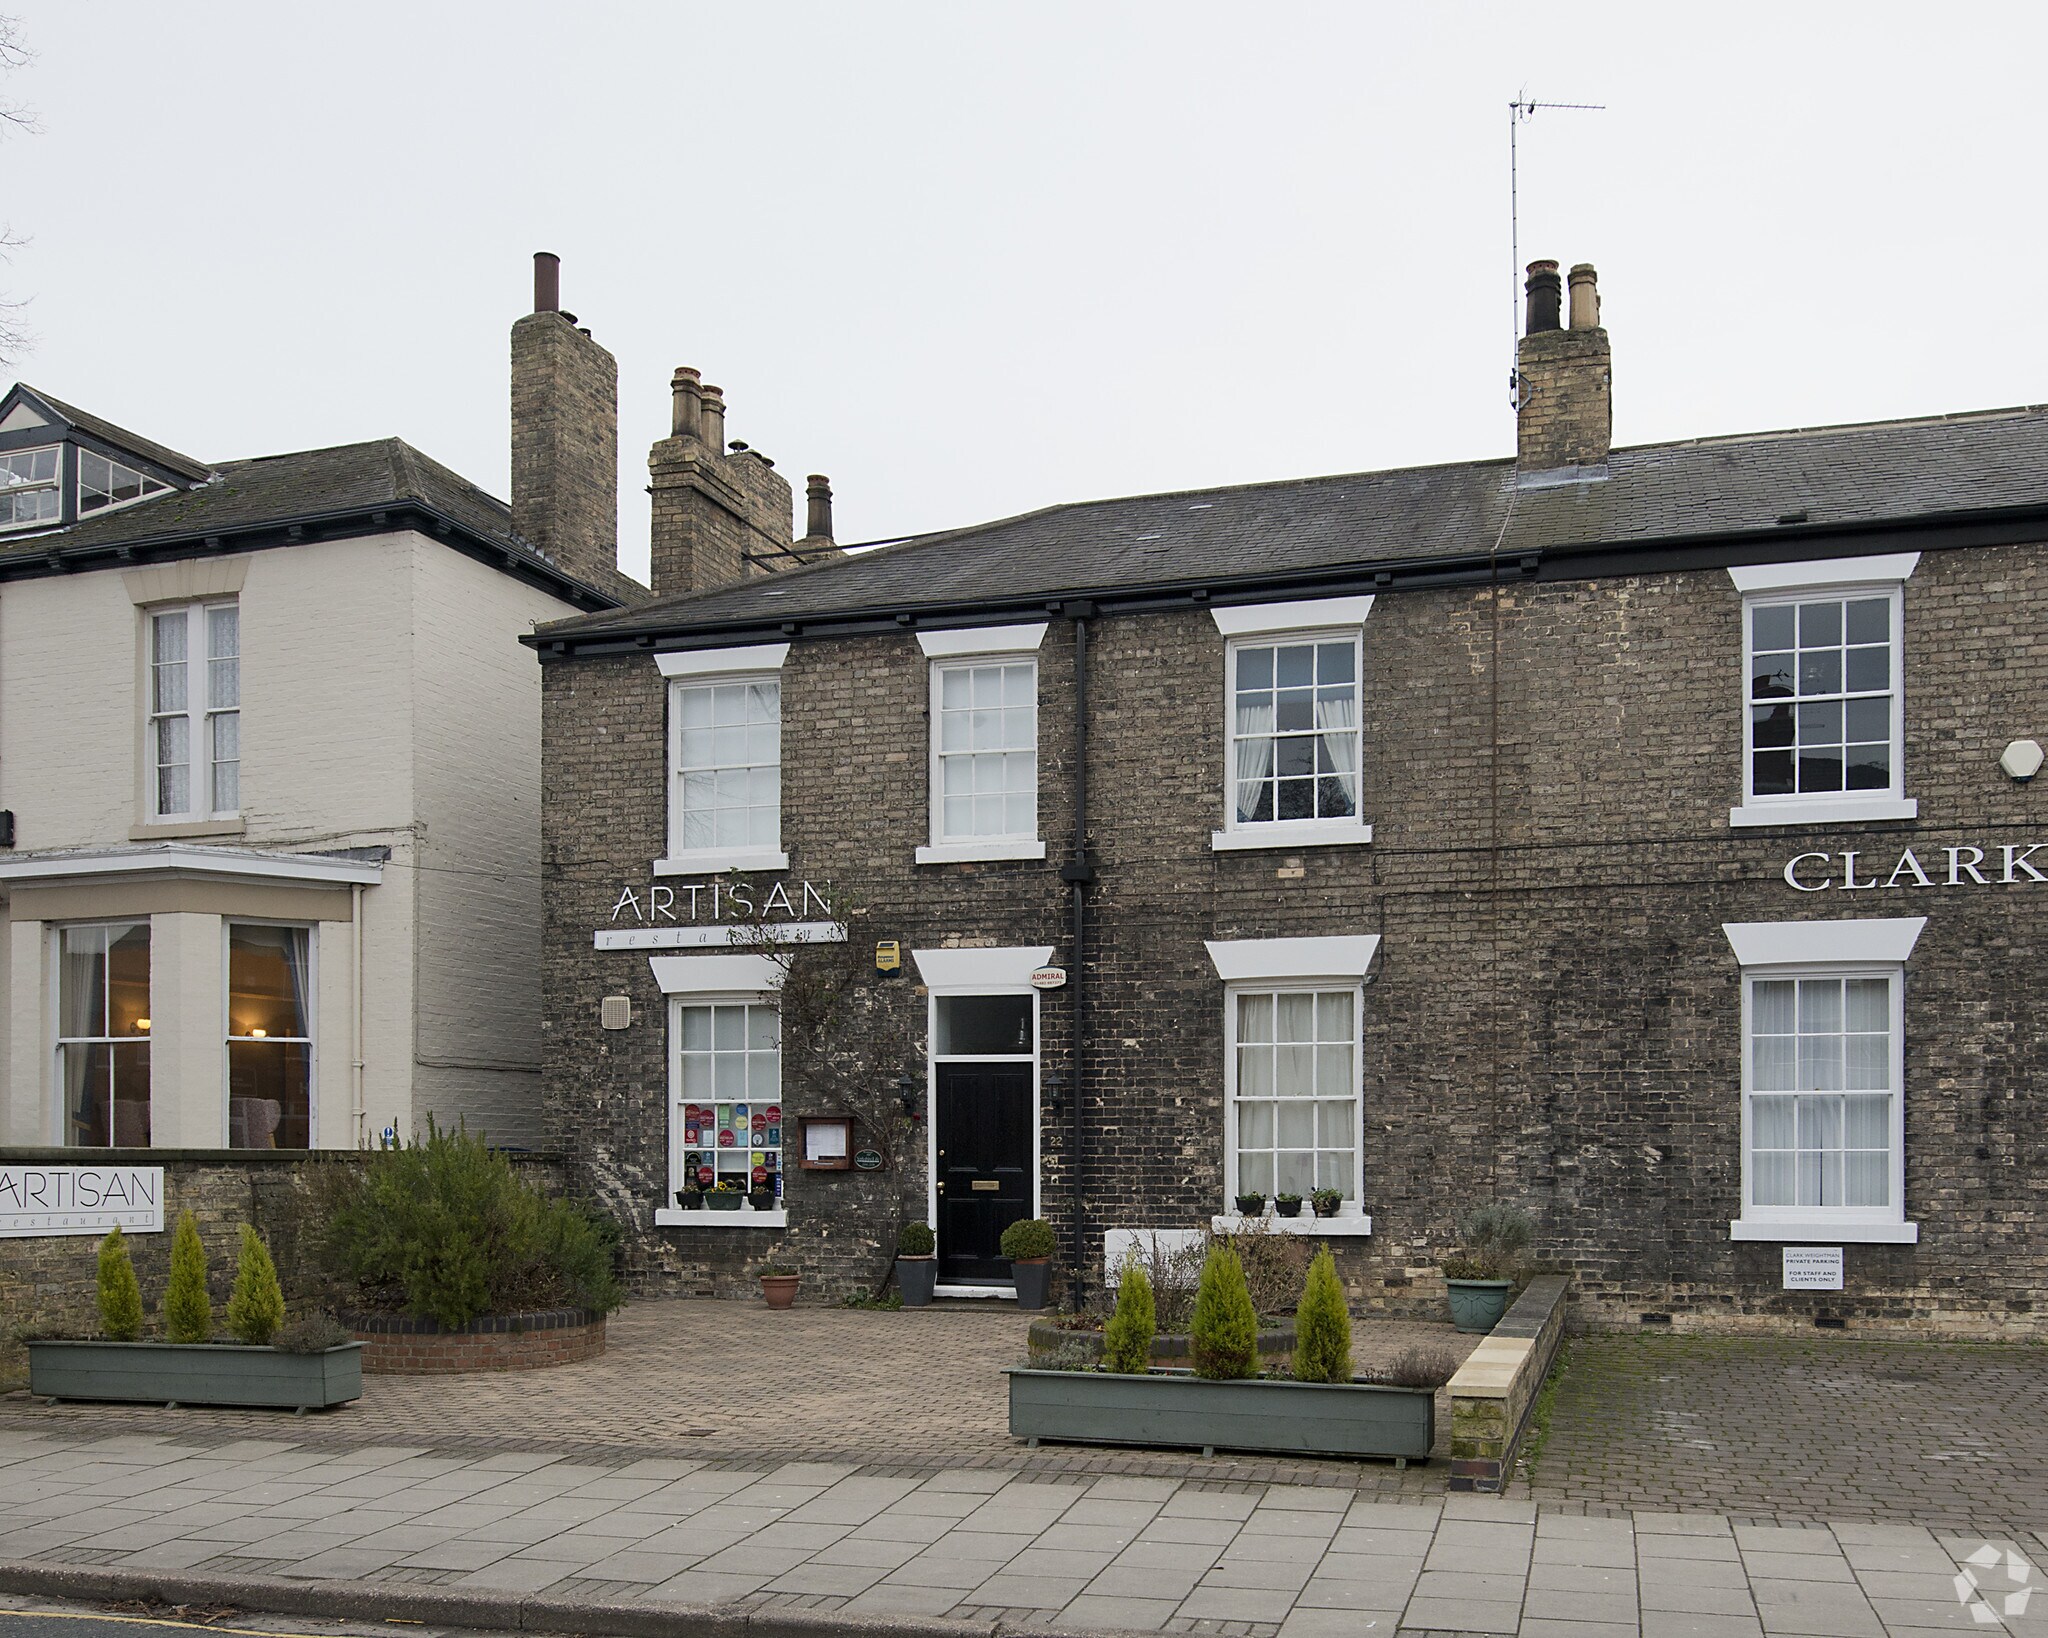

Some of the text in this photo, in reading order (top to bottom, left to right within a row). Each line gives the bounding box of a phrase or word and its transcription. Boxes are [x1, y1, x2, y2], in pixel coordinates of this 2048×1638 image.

[1783, 843, 2048, 891] CLARK
[611, 879, 832, 921] ARTISAN
[1050, 1136, 1063, 1147] 22
[0, 1172, 155, 1208] ARTISAN
[0, 1213, 149, 1227] estaurant
